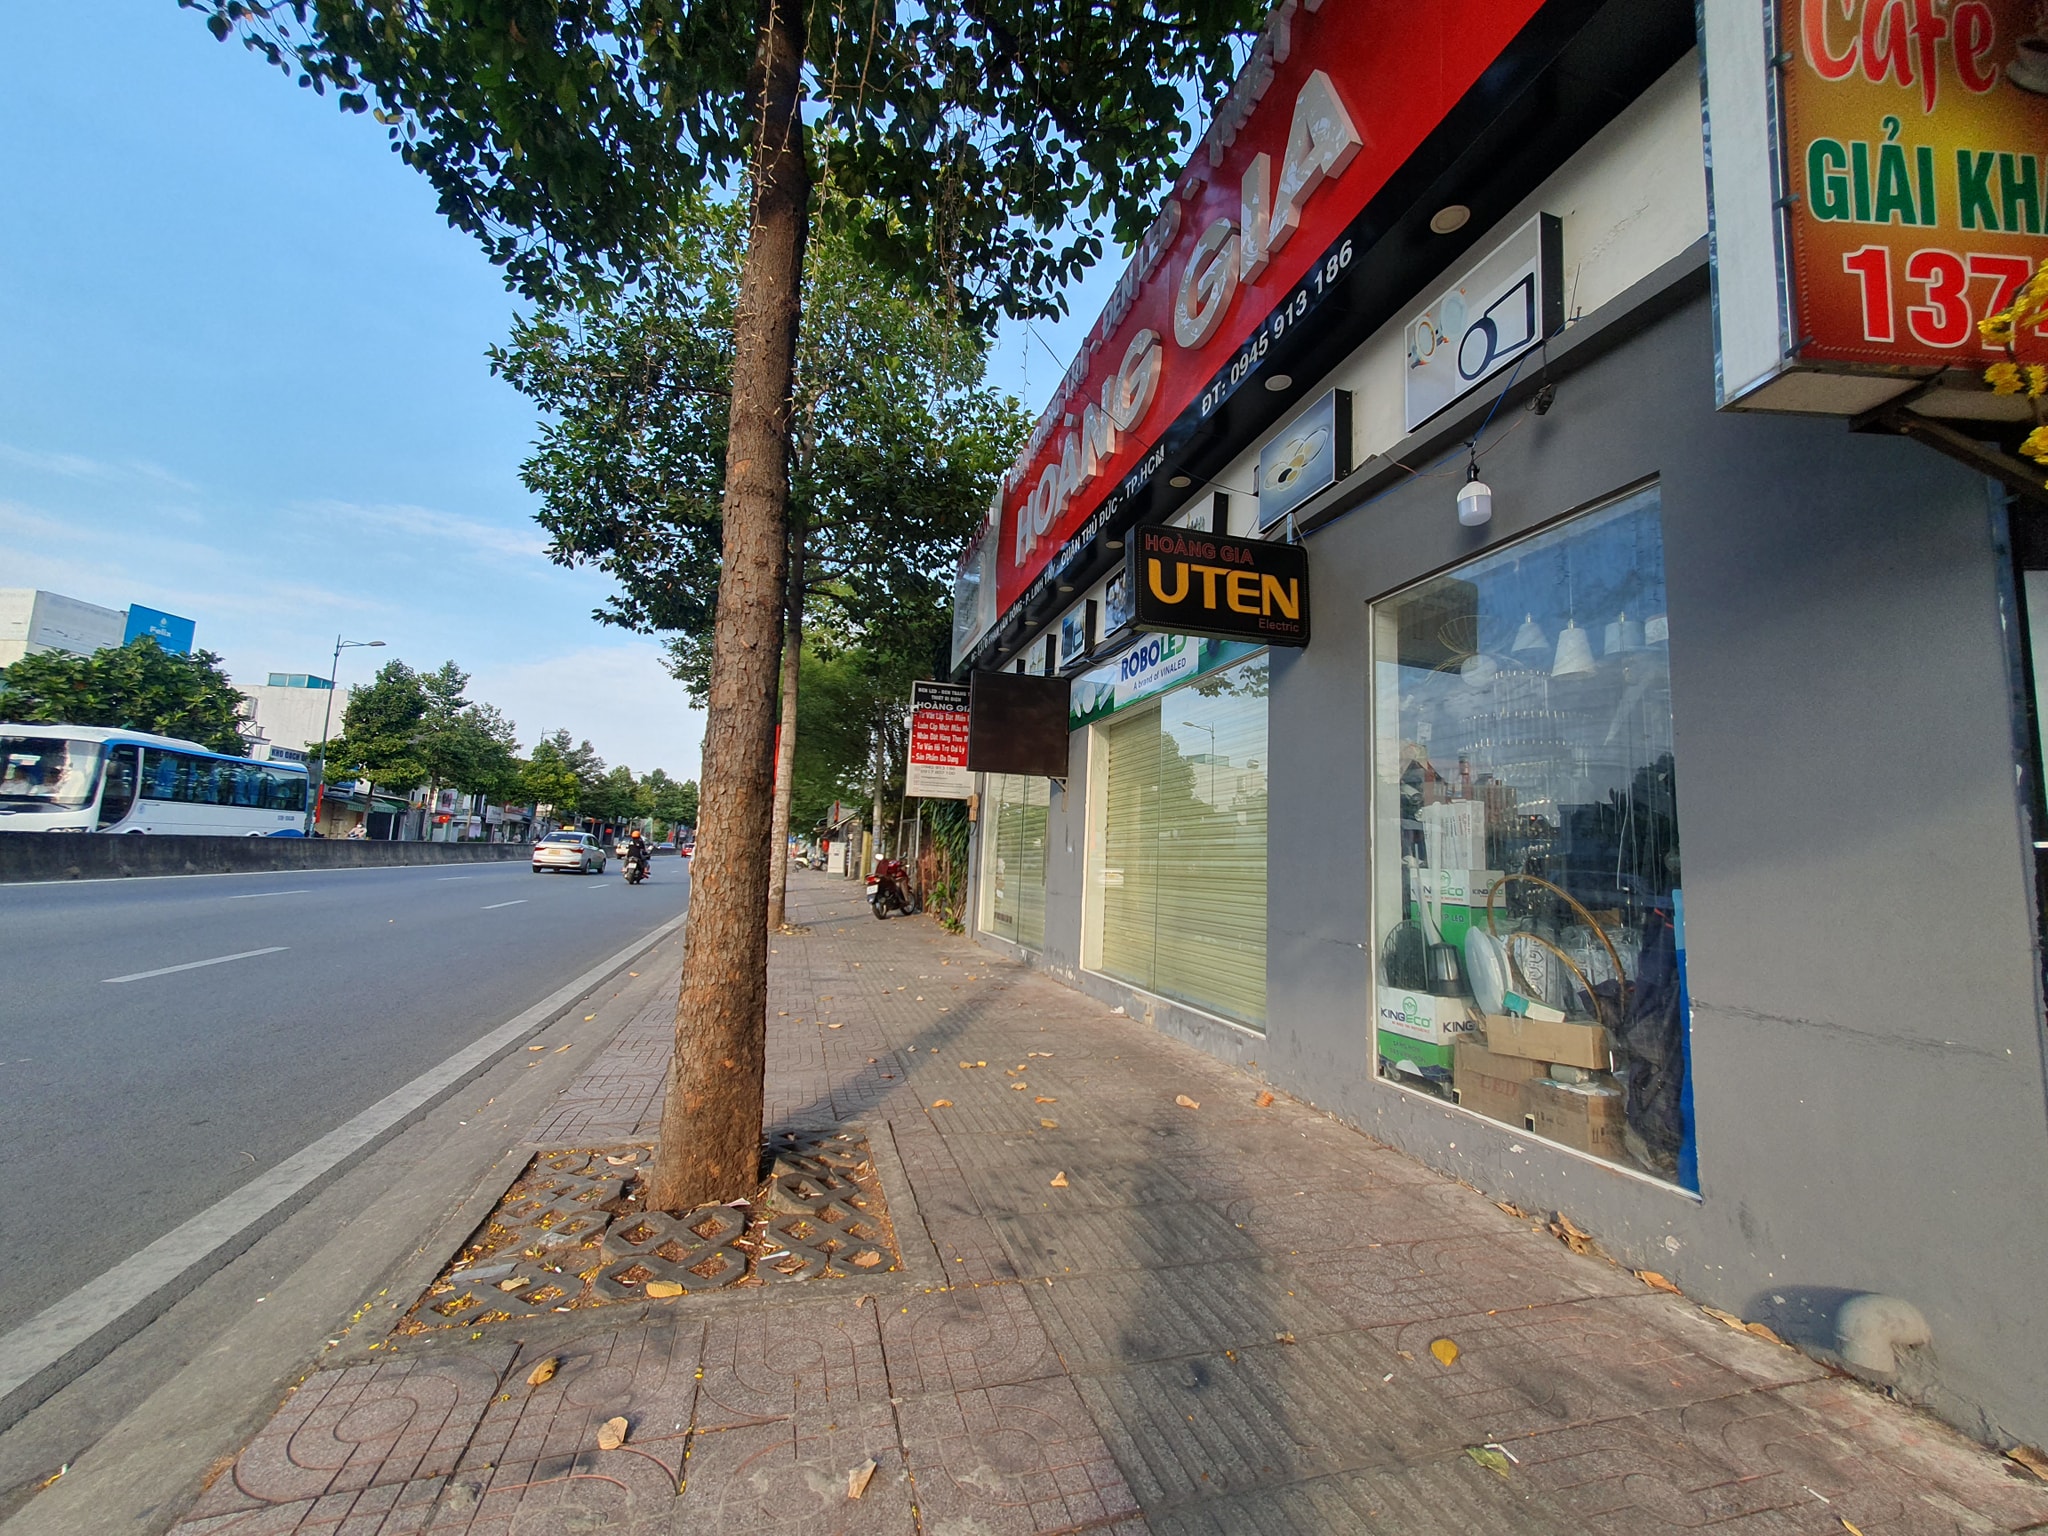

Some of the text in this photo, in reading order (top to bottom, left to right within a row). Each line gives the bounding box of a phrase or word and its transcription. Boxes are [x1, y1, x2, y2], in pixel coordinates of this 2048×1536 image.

[1807, 115, 2048, 235] GIẢI KH
[1014, 68, 1364, 569] HOÀNG GIA
[1201, 239, 1353, 417] ĐT: 0945 913 186
[1081, 514, 1098, 545] THỦ
[1099, 496, 1118, 528] ĐỨC
[1124, 443, 1165, 499] TP.HCM
[1144, 532, 1255, 566] HOÀNG GIA
[1147, 557, 1300, 620] UTEN
[1257, 618, 1300, 634] Electric
[1133, 657, 1187, 691] A brand of VINALED
[916, 700, 954, 711] HOÀNG
[1380, 1007, 1431, 1028] KINGECO
